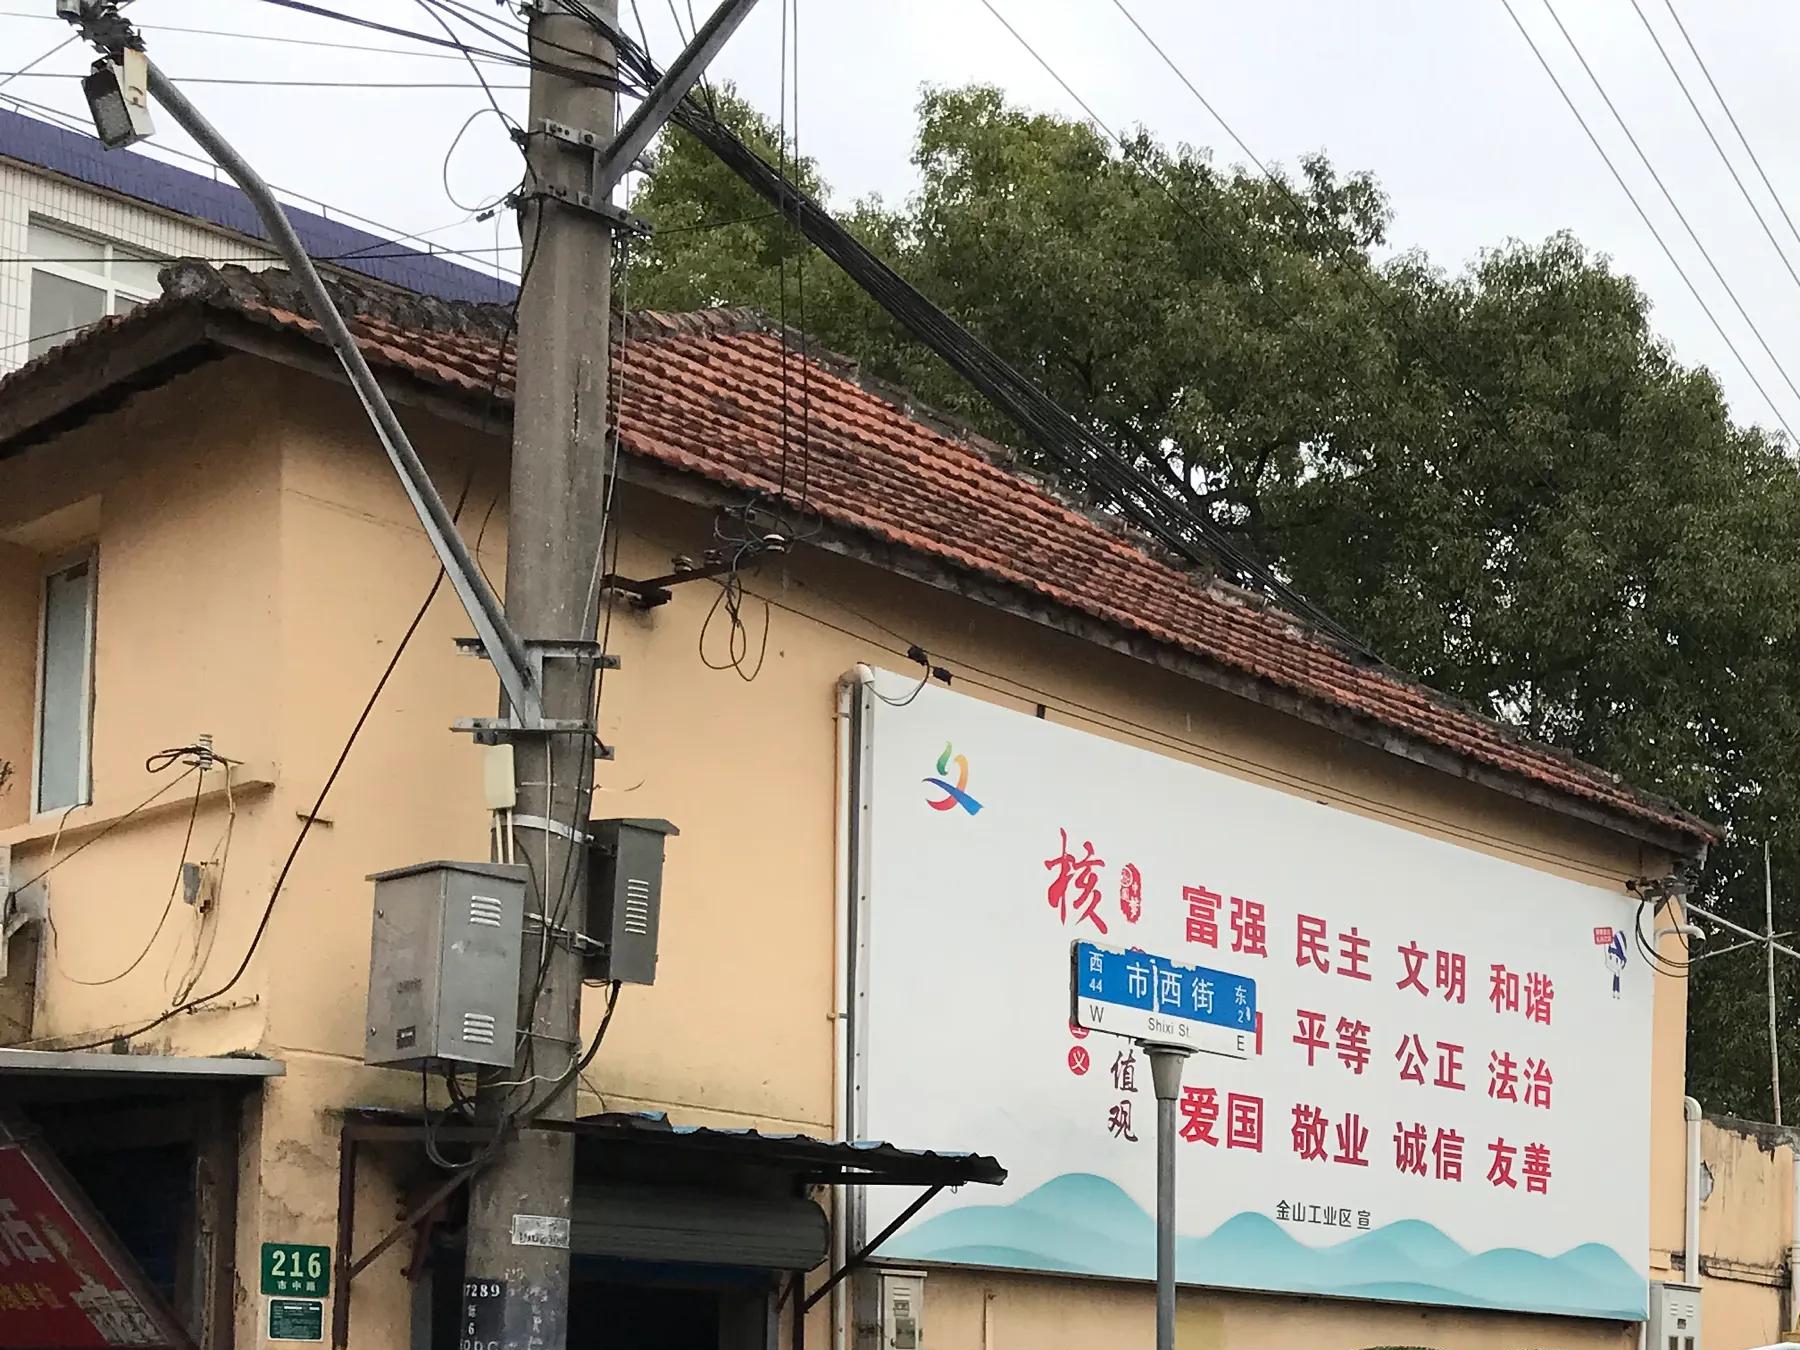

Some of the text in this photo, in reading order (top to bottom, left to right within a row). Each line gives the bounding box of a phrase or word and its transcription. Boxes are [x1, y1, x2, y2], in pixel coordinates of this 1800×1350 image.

[1089, 951, 1104, 974] 西
[1183, 885, 1554, 1025] 富强 民主 文明 和谐
[1089, 978, 1103, 993] 44
[1126, 961, 1215, 1015] 市西街
[1234, 985, 1247, 1006] 东
[1090, 1004, 1104, 1024] W
[1148, 1017, 1174, 1036] Shixi
[1237, 1034, 1245, 1052] E
[1293, 1010, 1369, 1074] 平等
[1396, 1036, 1464, 1091] 公正
[1488, 1052, 1552, 1108] 法治
[1108, 1034, 1139, 1143] 值观
[1179, 1086, 1552, 1195] 爱国 敬业 诚信 友善
[1276, 1200, 1370, 1229] 金山工业区 宣
[271, 1250, 322, 1278] 216
